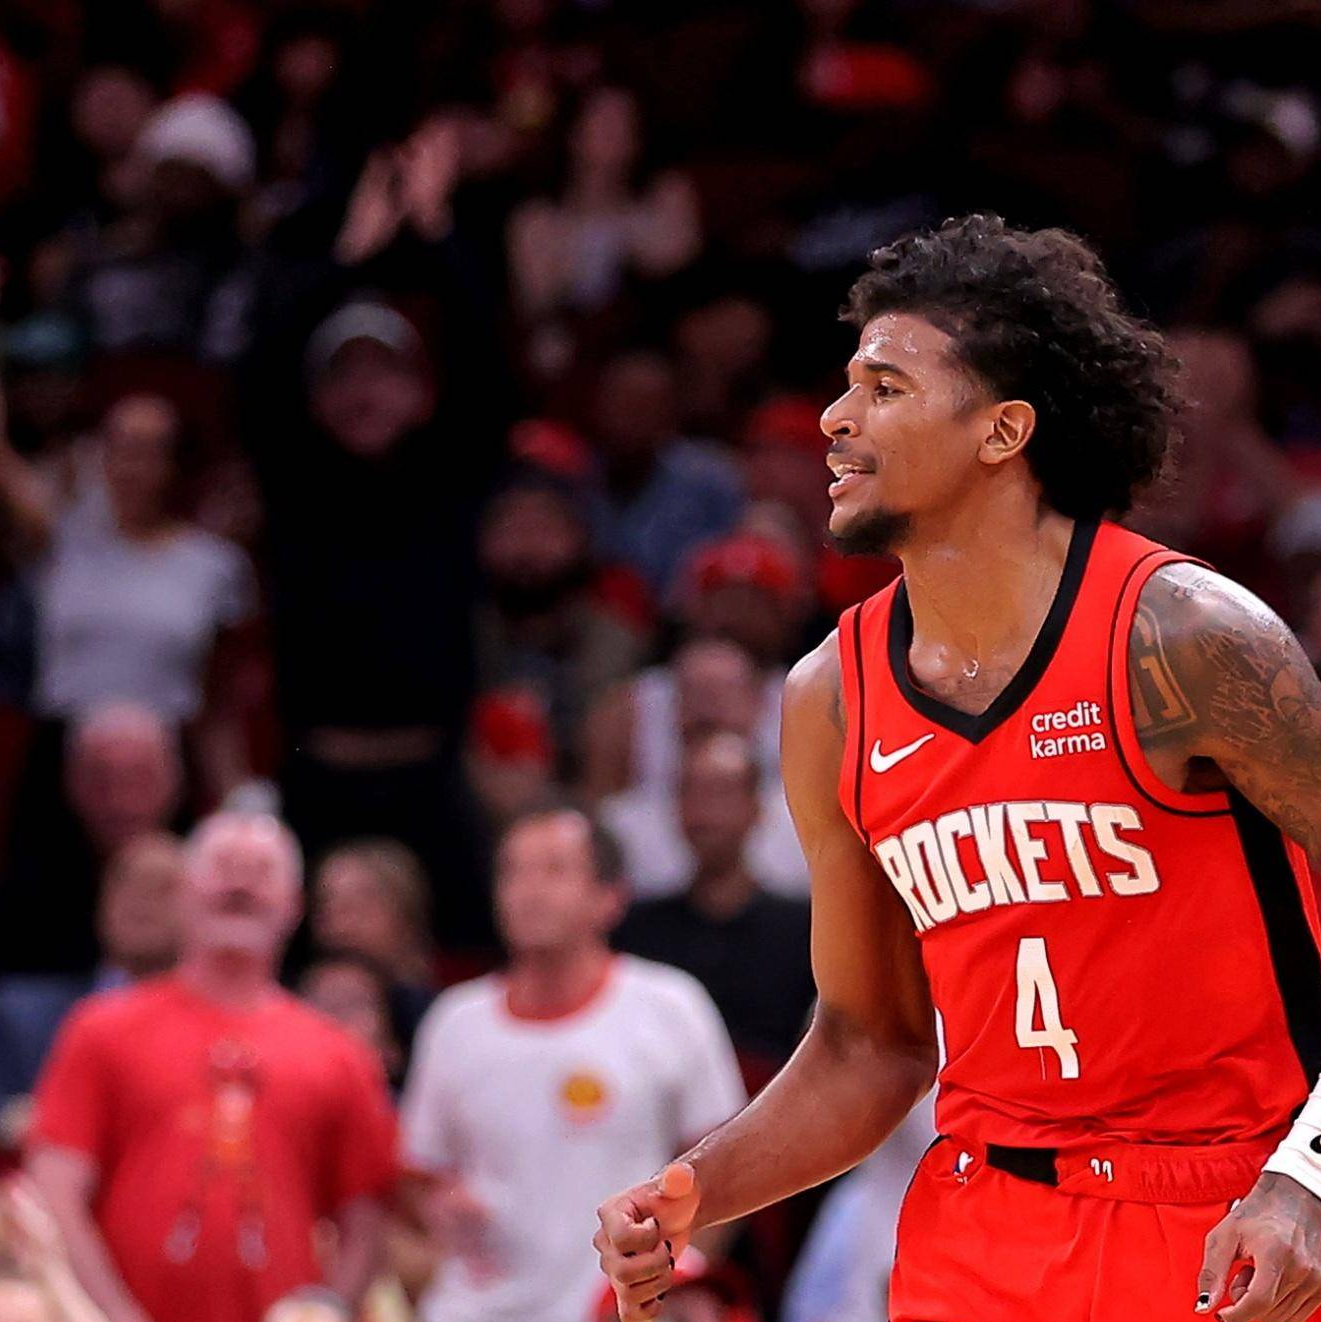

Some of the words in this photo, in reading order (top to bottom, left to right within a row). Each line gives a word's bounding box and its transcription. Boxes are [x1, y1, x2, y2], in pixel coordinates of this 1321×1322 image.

[1029, 732, 1106, 758] karma
[1032, 701, 1102, 733] credit
[874, 799, 1160, 932] ROCKETS
[1015, 937, 1080, 1080] 4
